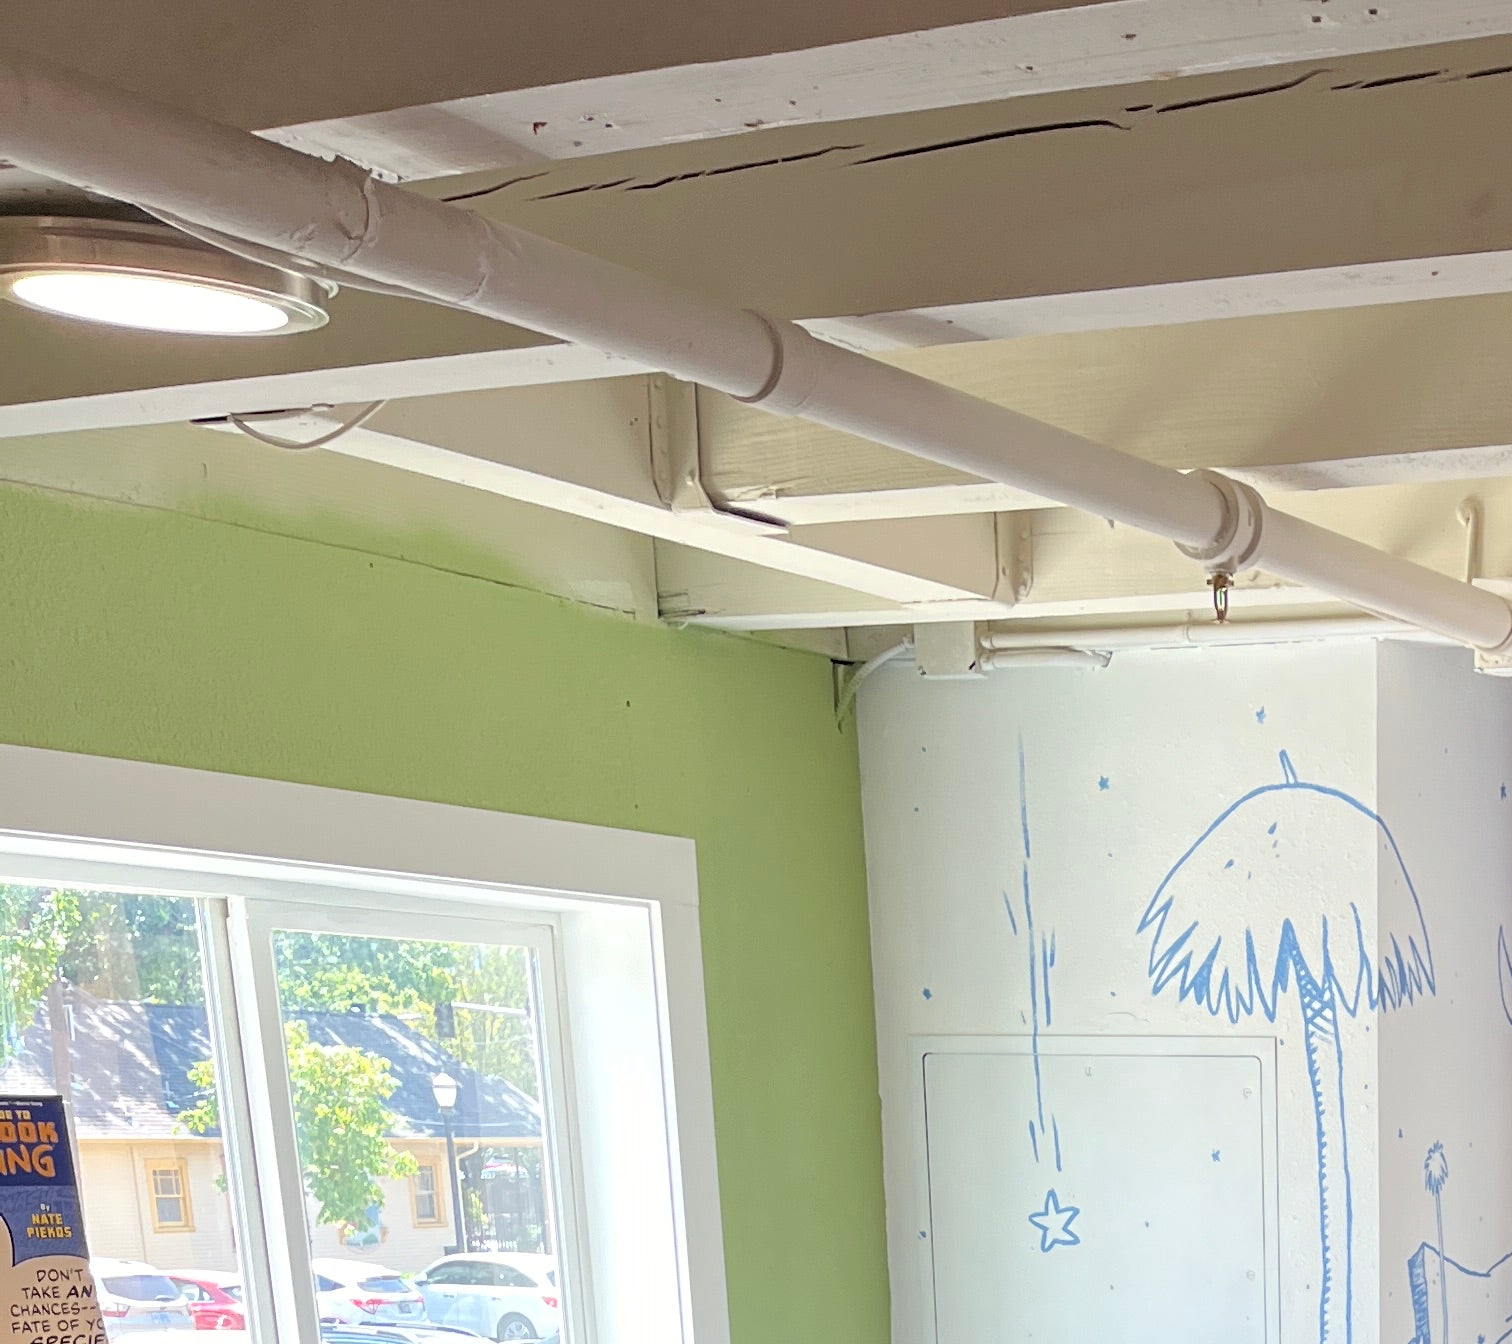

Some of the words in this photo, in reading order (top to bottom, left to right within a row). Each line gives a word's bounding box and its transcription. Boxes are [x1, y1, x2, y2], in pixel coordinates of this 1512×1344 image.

[31, 1213, 63, 1225] NATE
[26, 1227, 72, 1239] PIEKOS
[36, 1268, 83, 1282] DON'T
[21, 1286, 61, 1299] TAKE
[12, 1320, 51, 1334] FATE
[57, 1319, 79, 1332] OF
